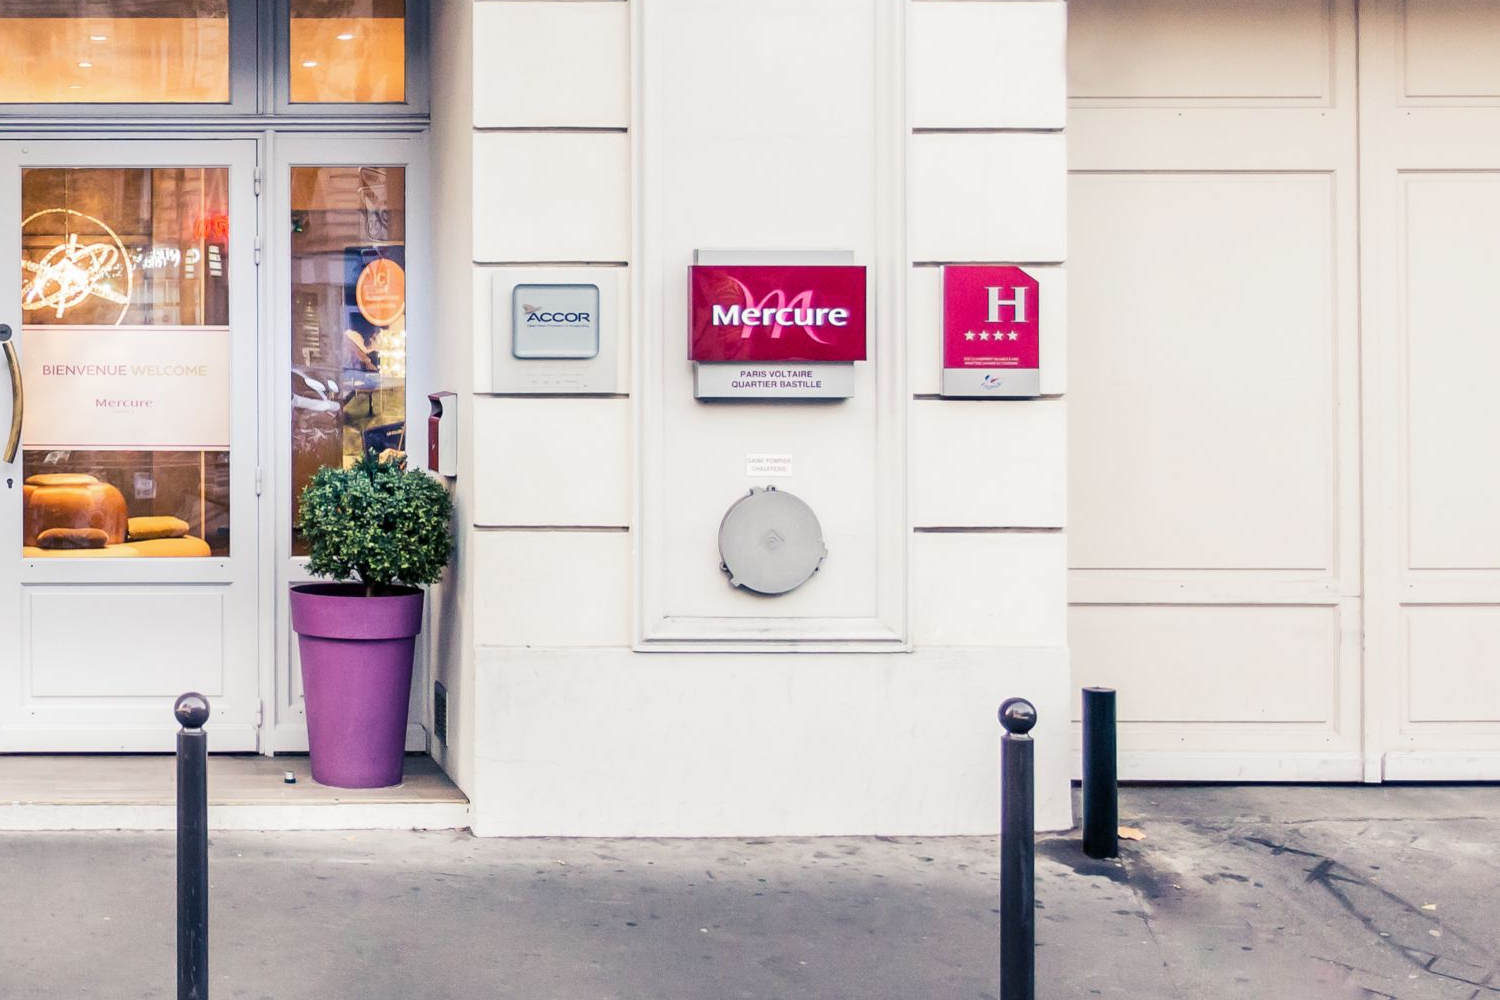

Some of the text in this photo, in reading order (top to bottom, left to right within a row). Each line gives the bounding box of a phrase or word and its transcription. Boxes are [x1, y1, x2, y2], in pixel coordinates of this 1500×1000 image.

[983, 286, 1030, 323] H
[526, 312, 591, 323] ACCOR
[712, 304, 849, 326] Mercure
[41, 364, 208, 377] BIENVENUE WELCOME
[740, 370, 813, 378] PARIS VOLTAIRE
[731, 380, 822, 389] QUARTIER BASTILLE
[94, 398, 154, 408] Mercure
